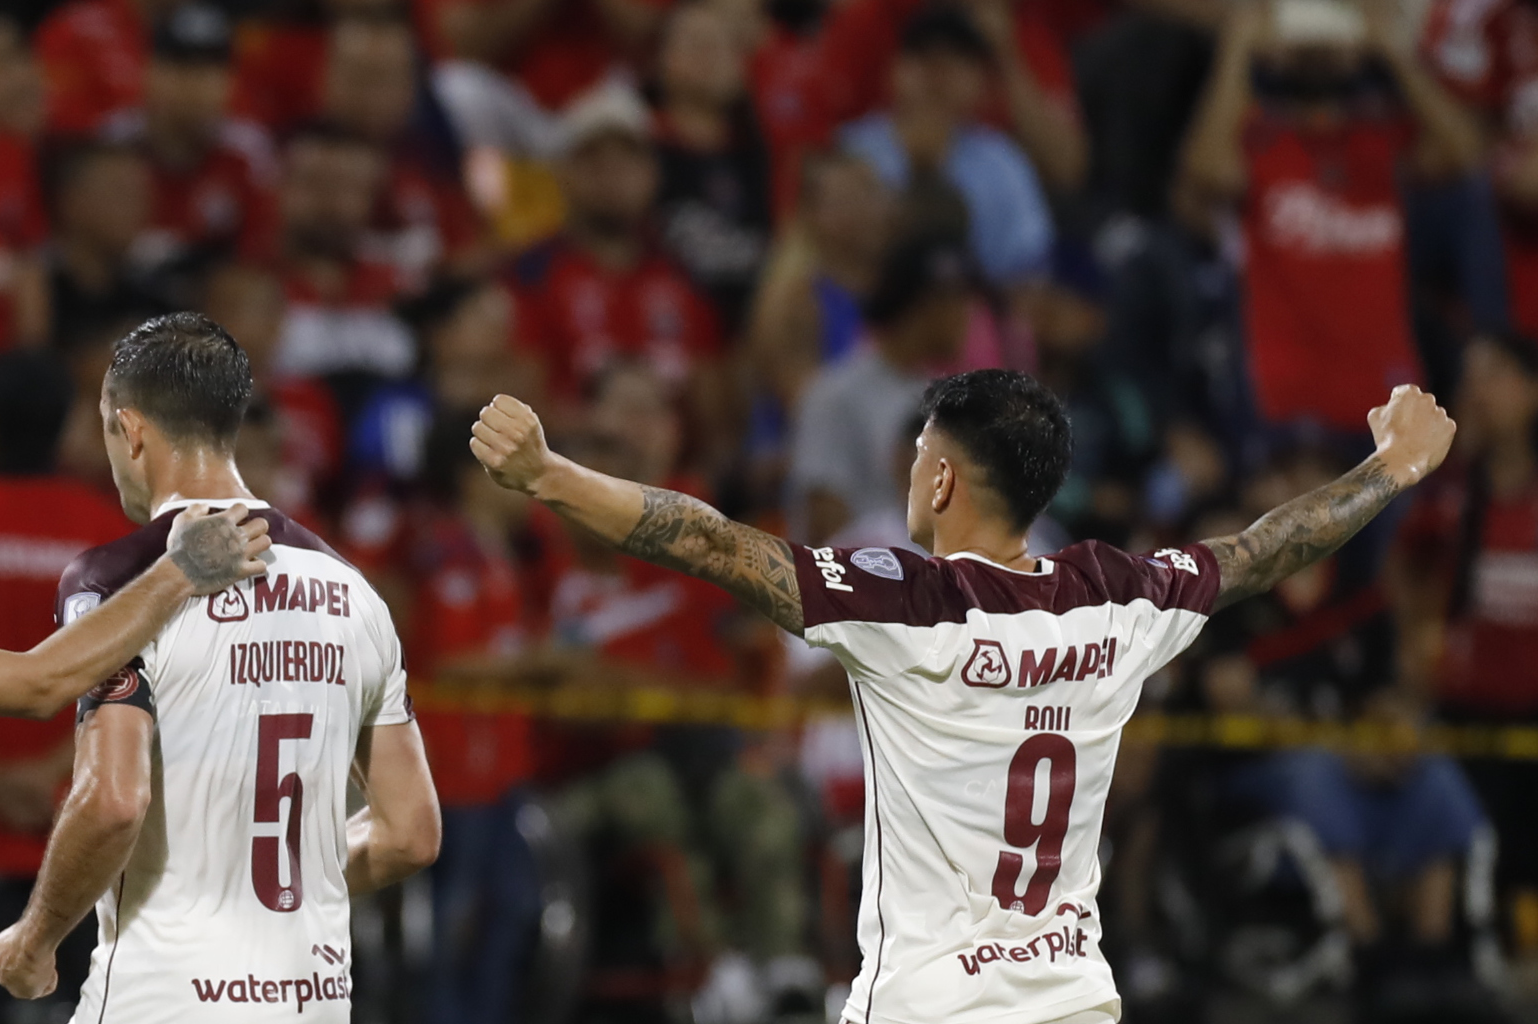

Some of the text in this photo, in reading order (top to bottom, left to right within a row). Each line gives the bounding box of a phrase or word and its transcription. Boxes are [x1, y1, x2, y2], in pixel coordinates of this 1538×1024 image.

[254, 573, 351, 618] MAPEI
[230, 640, 346, 688] IZQUIERDOZ
[1017, 637, 1117, 688] MAPEI
[251, 713, 314, 912] 5
[991, 732, 1077, 916] 9
